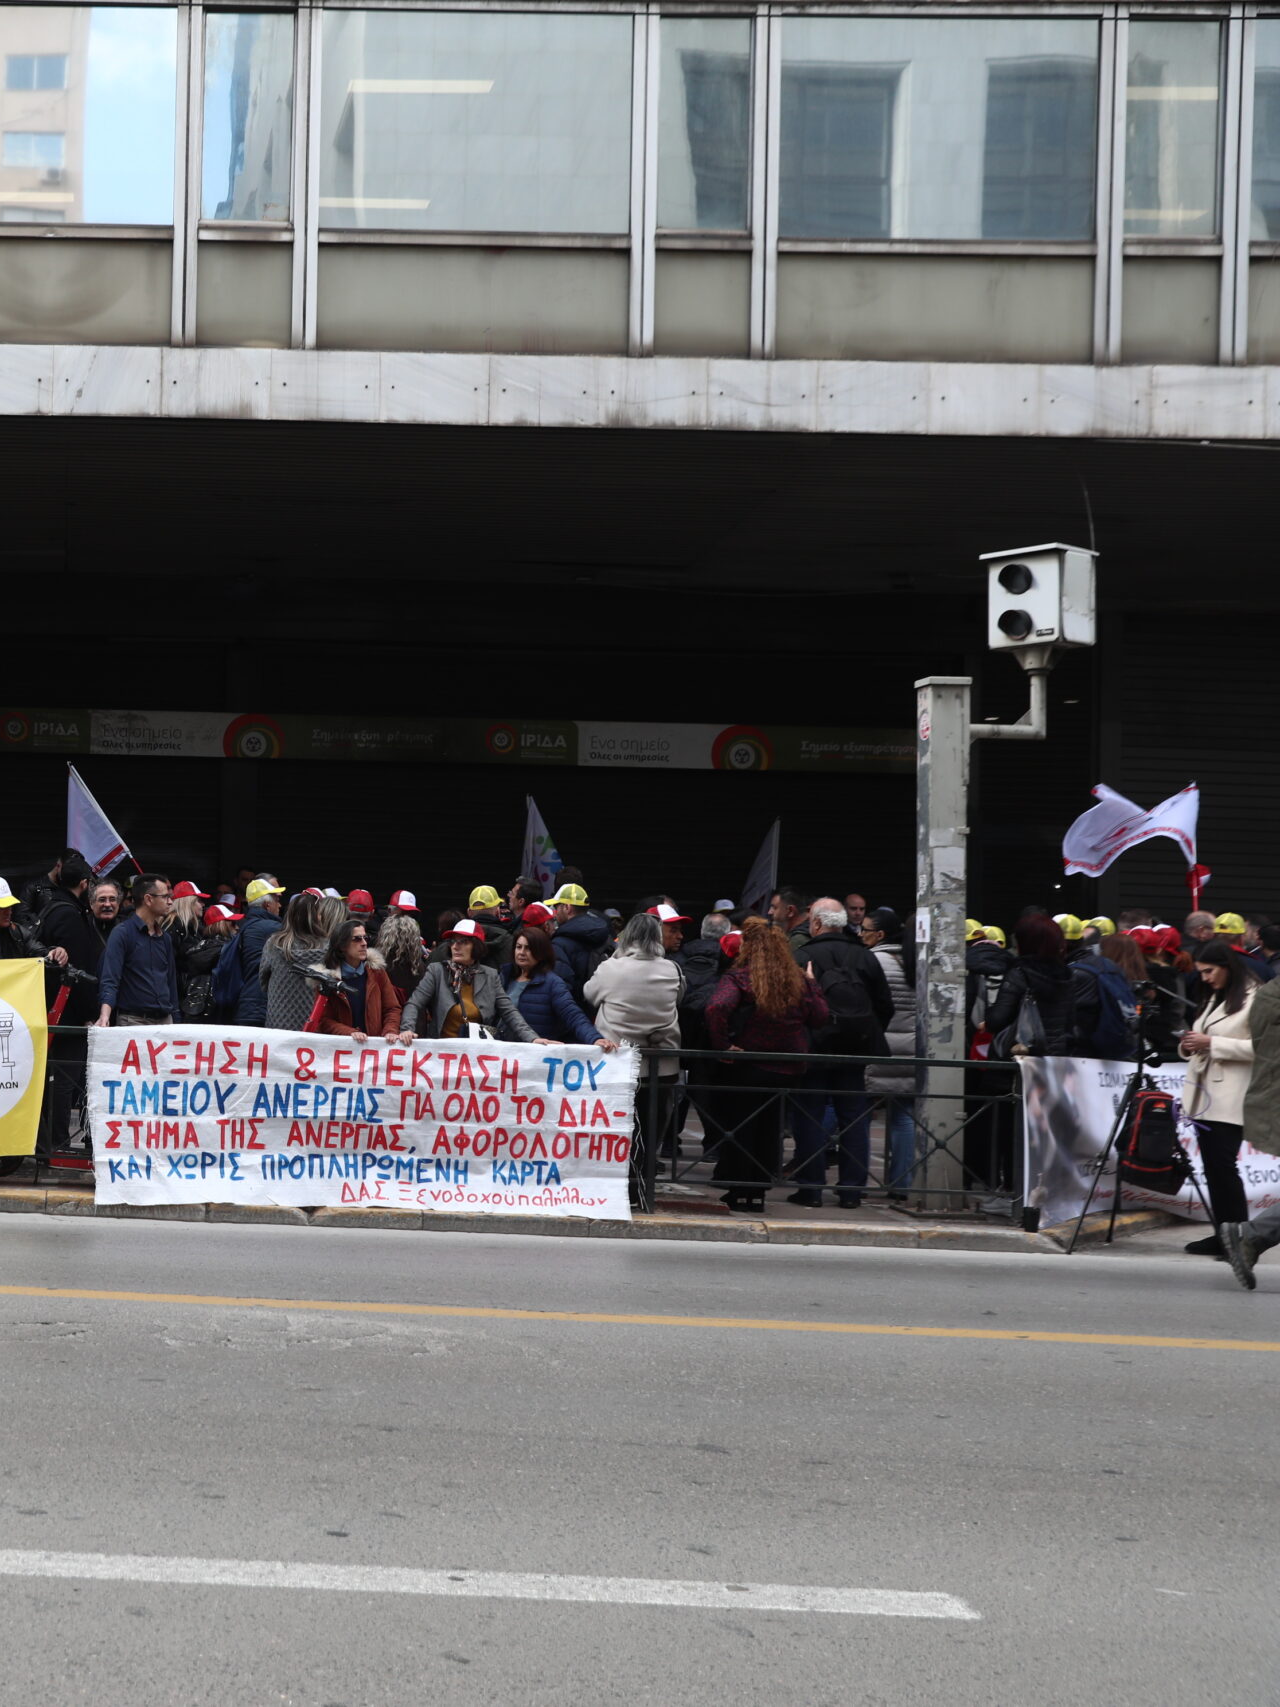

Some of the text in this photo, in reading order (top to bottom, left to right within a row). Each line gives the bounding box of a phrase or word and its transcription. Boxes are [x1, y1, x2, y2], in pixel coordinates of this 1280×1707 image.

[521, 734, 567, 748] ΙΡΙΔΑ
[121, 1039, 607, 1094] ΑΥΞΗΣΗ & ΕΠΕΚΤΑΣΗ ΤΟΥ
[102, 1080, 237, 1116] ΤΑΜΕΙΟΥ
[252, 1082, 385, 1123] ΑΝΕΡΓΙΑΣ
[443, 1092, 500, 1123] ΟΛΟ
[510, 1095, 545, 1125] ΤΟ
[104, 1120, 200, 1150] ΣΤΗΜΑ
[216, 1118, 266, 1150] ΤΗΣ
[432, 1125, 631, 1163] ΑΦΟΡΟΛΟΓΗΤΟ
[108, 1151, 562, 1186] ΚΑΙ ΧΩΡΙΣ ΠΡΟΠΛΗΡΩΜΕΝΗ ΚΑΡΤΑ
